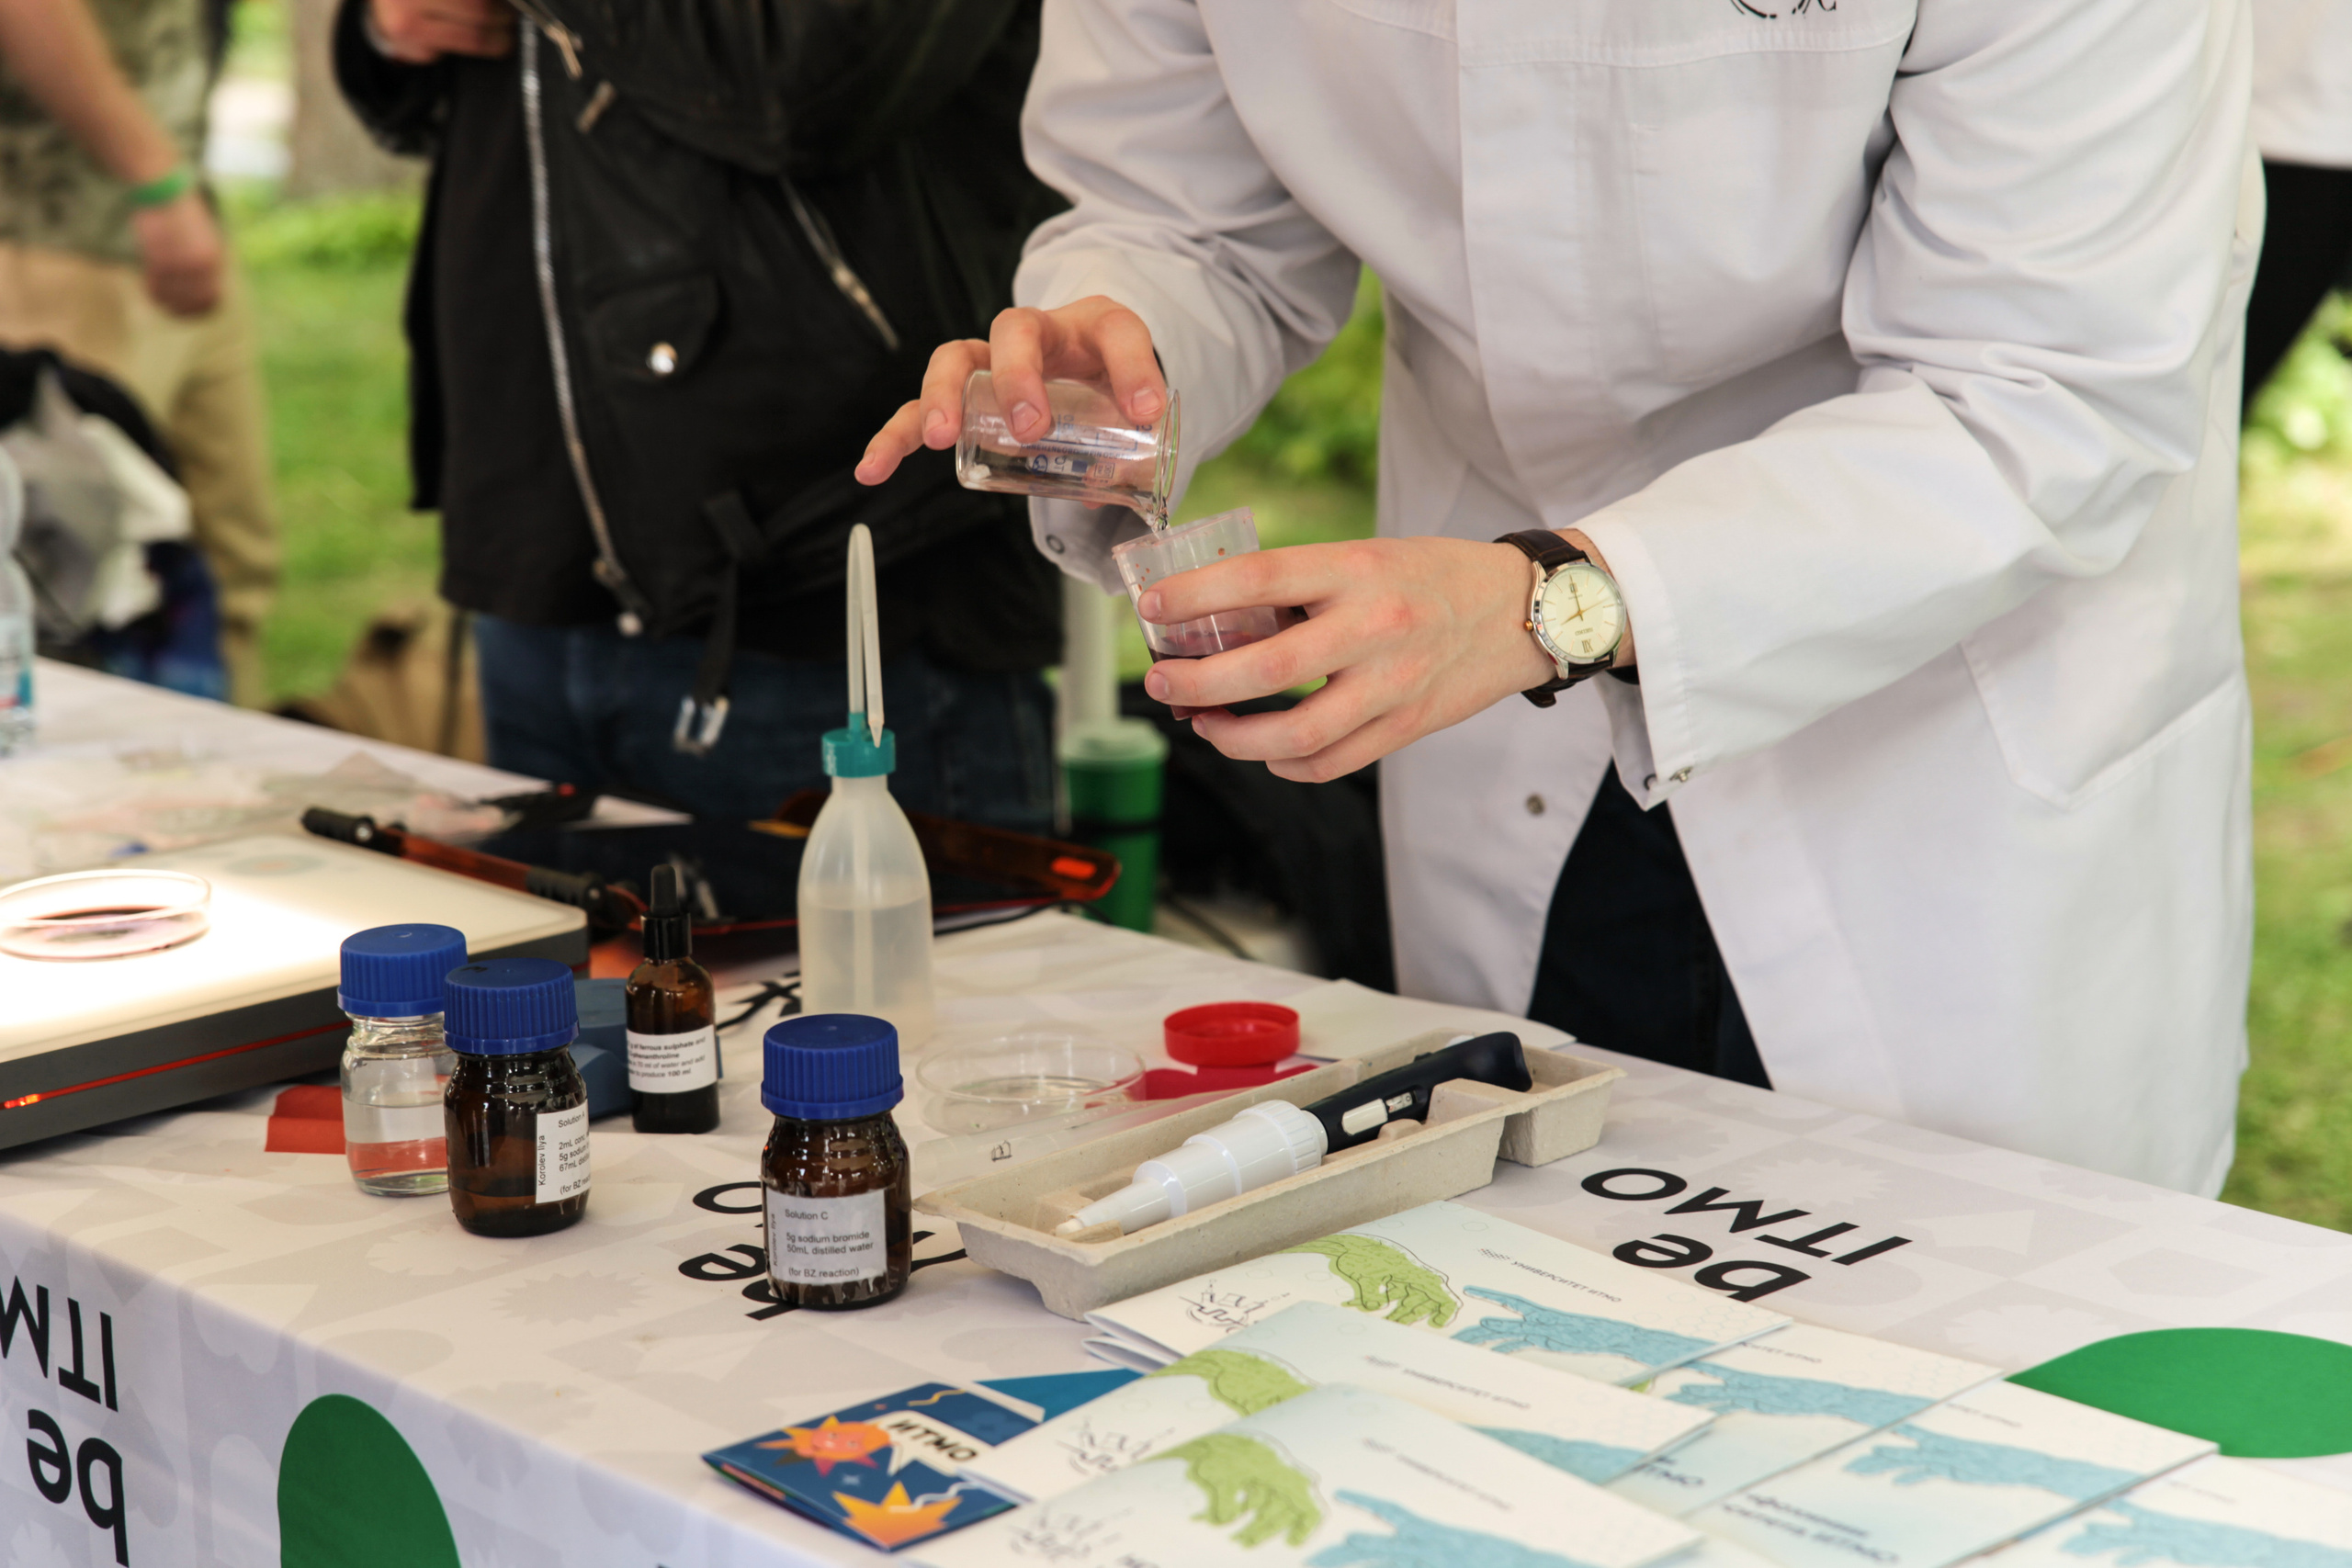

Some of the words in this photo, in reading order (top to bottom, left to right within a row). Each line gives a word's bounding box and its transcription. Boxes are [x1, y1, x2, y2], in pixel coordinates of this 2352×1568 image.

[663, 1041, 695, 1050] sulphate
[695, 1036, 706, 1045] and
[681, 1058, 694, 1066] and
[558, 1113, 582, 1128] Solution
[538, 1135, 547, 1150] Ilya
[559, 1139, 573, 1150] 2mL
[559, 1152, 569, 1162] 5g
[538, 1153, 547, 1186] Korolev
[559, 1161, 578, 1172] 67mL
[560, 1184, 571, 1195] (for
[573, 1179, 581, 1190] BZ
[785, 1209, 819, 1220] Solution
[820, 1211, 829, 1221] C
[1580, 1168, 1914, 1267] ITMO
[786, 1232, 796, 1243] 5g
[798, 1233, 831, 1243] sodium
[832, 1231, 870, 1241] bromide
[786, 1244, 809, 1255] 50mL
[812, 1243, 846, 1255] distilled
[849, 1242, 874, 1253] water
[788, 1268, 802, 1278] (for
[804, 1269, 817, 1278] BZ
[819, 1267, 860, 1278] reaction)
[1612, 1233, 1813, 1303] be
[1510, 1260, 1589, 1291] УНИВЕРСИТЕТ
[1588, 1288, 1622, 1303] ИТМО
[0, 1275, 118, 1412] ITM
[888, 1418, 979, 1462] ИТМО
[27, 1408, 130, 1568] be
